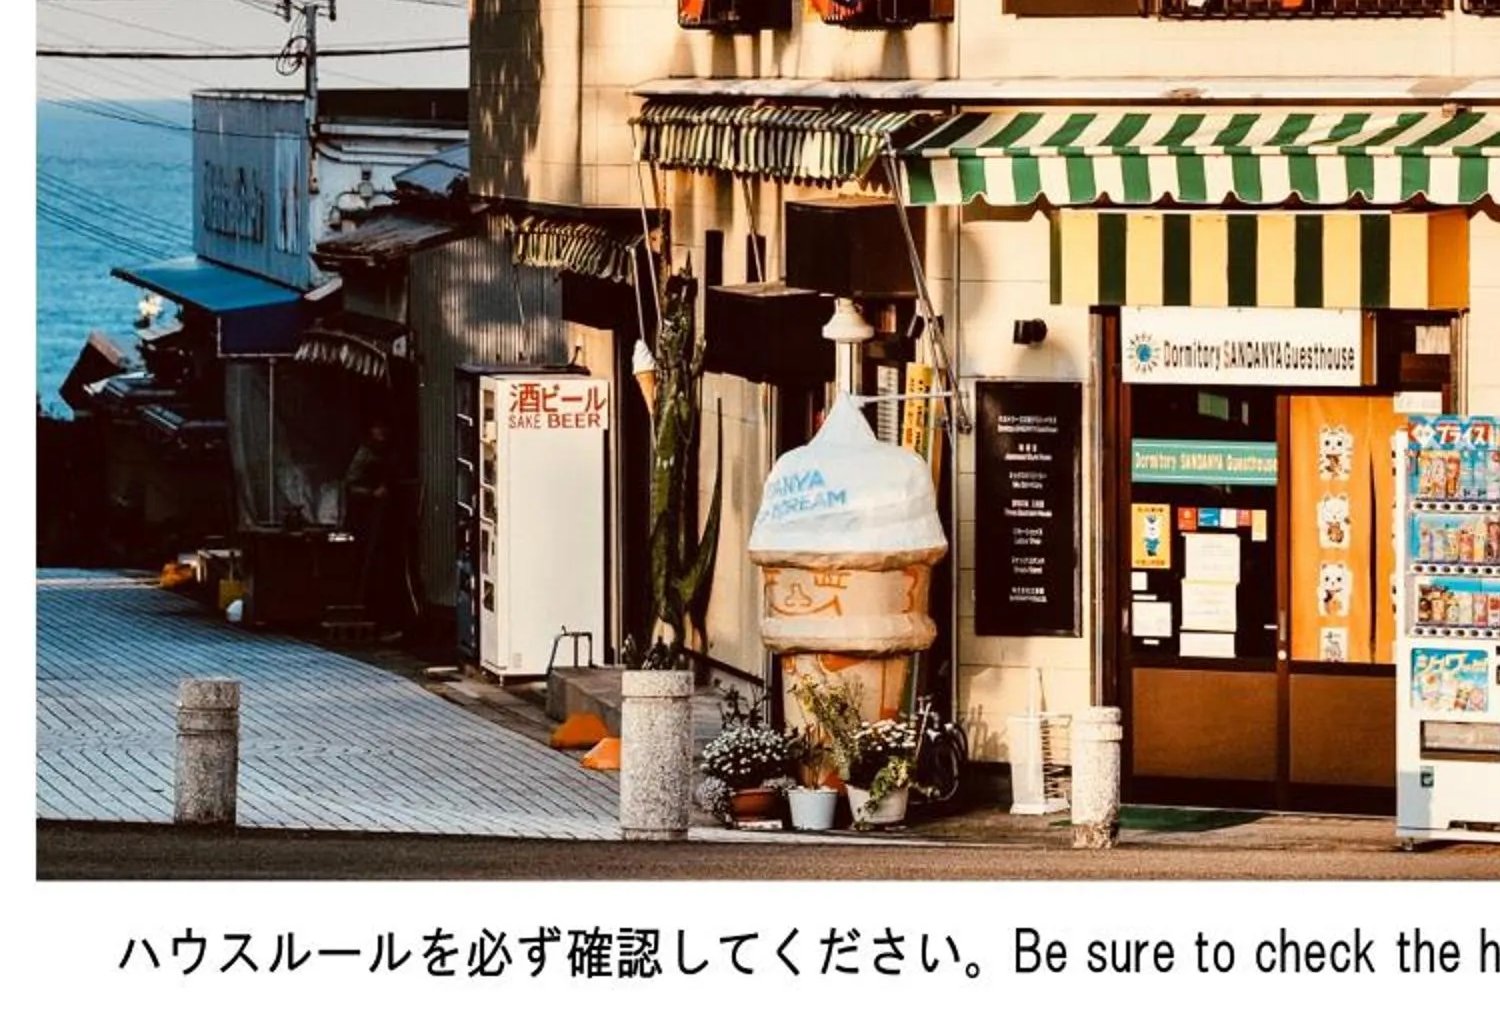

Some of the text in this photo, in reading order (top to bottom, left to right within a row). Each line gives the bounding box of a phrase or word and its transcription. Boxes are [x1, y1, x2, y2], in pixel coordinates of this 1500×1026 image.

[1163, 340, 1355, 371] Dormitory SANDANYA Guesthouse
[510, 382, 606, 413] 酒ビール
[508, 413, 601, 429] SAKE BEER
